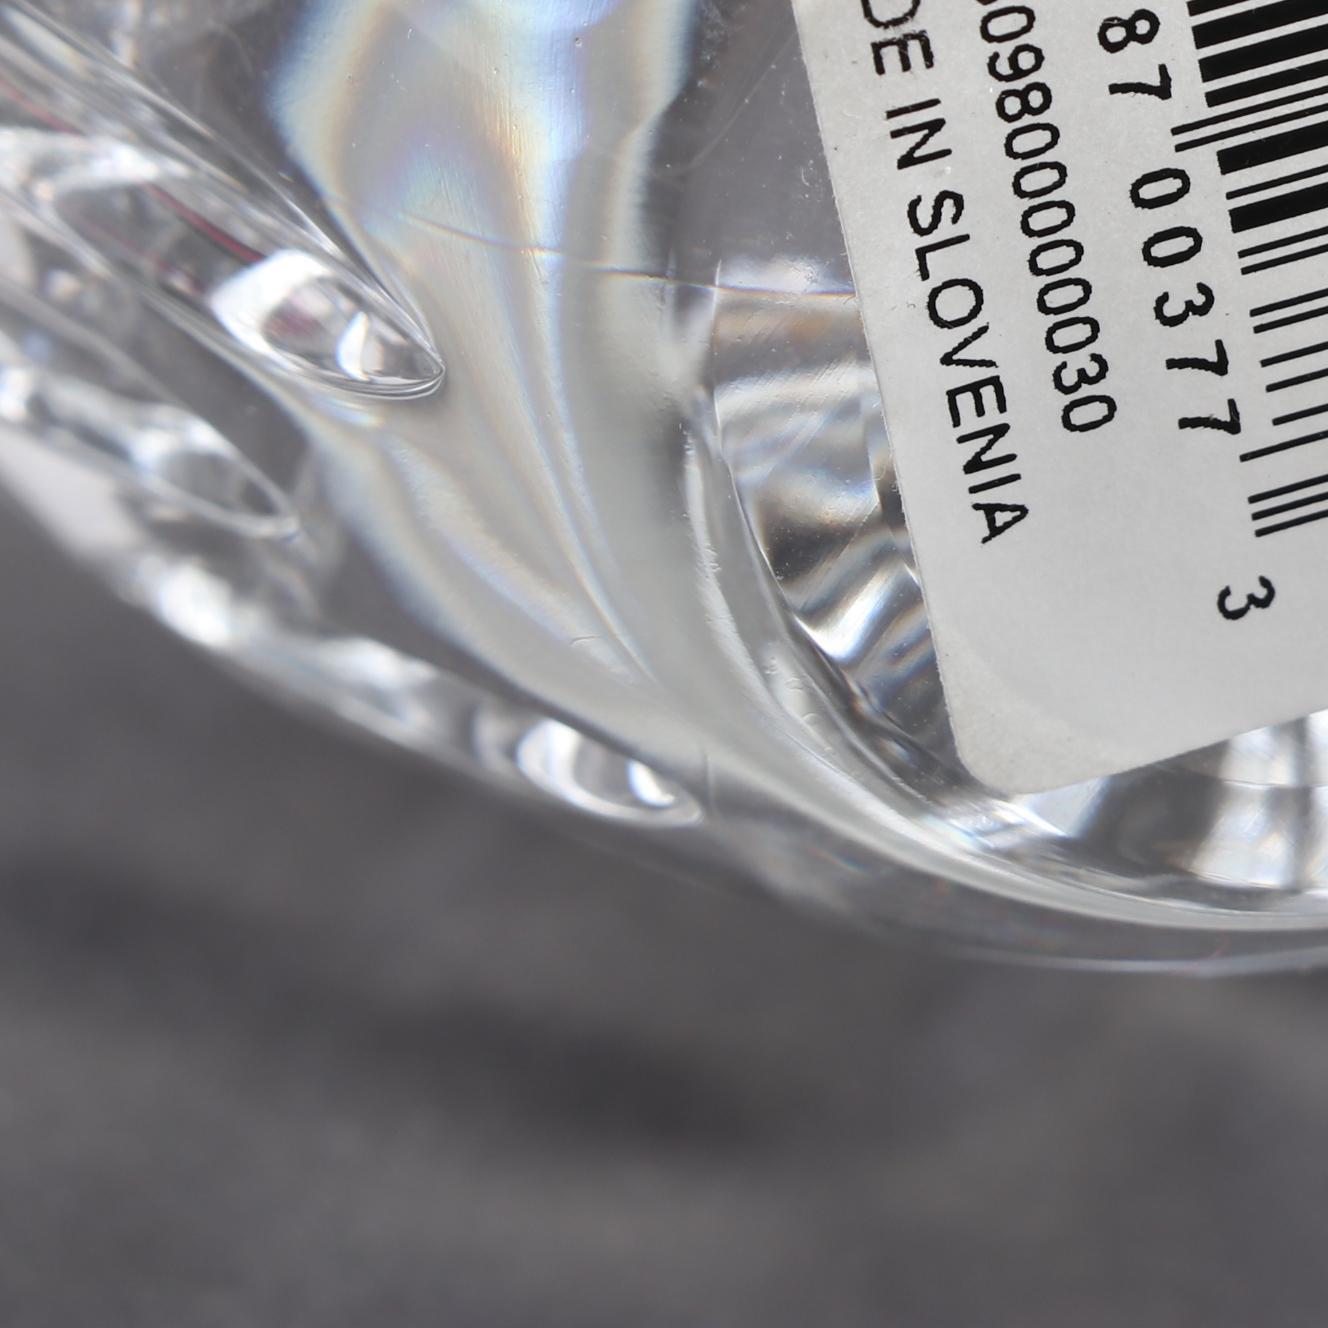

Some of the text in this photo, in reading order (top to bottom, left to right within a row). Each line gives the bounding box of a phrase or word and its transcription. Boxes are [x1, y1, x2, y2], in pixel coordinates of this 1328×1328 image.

[885, 98, 953, 171] IN
[906, 189, 1030, 545] SLOVENIA
[1216, 575, 1276, 621] 3
